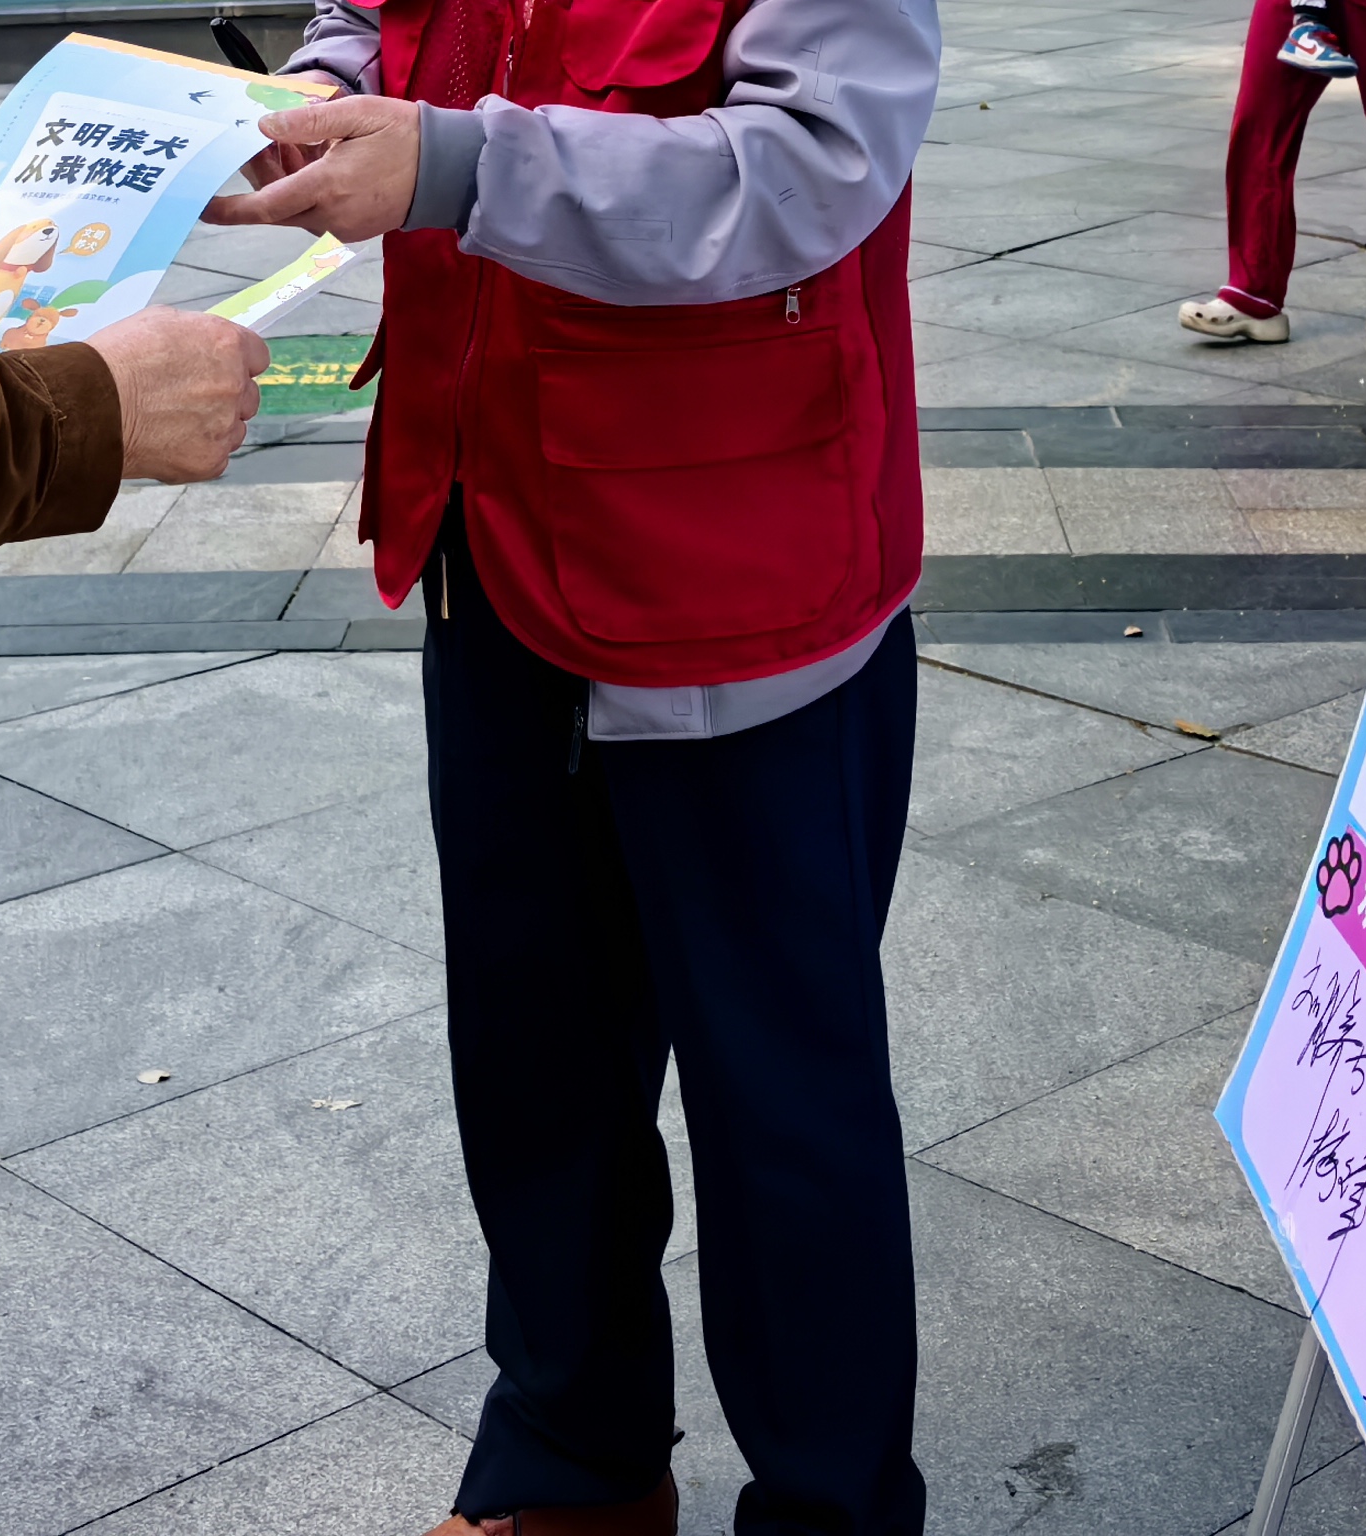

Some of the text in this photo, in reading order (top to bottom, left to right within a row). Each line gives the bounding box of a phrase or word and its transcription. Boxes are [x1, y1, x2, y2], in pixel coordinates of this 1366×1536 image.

[37, 117, 190, 160] 文明养犬
[14, 154, 167, 193] 从我做起
